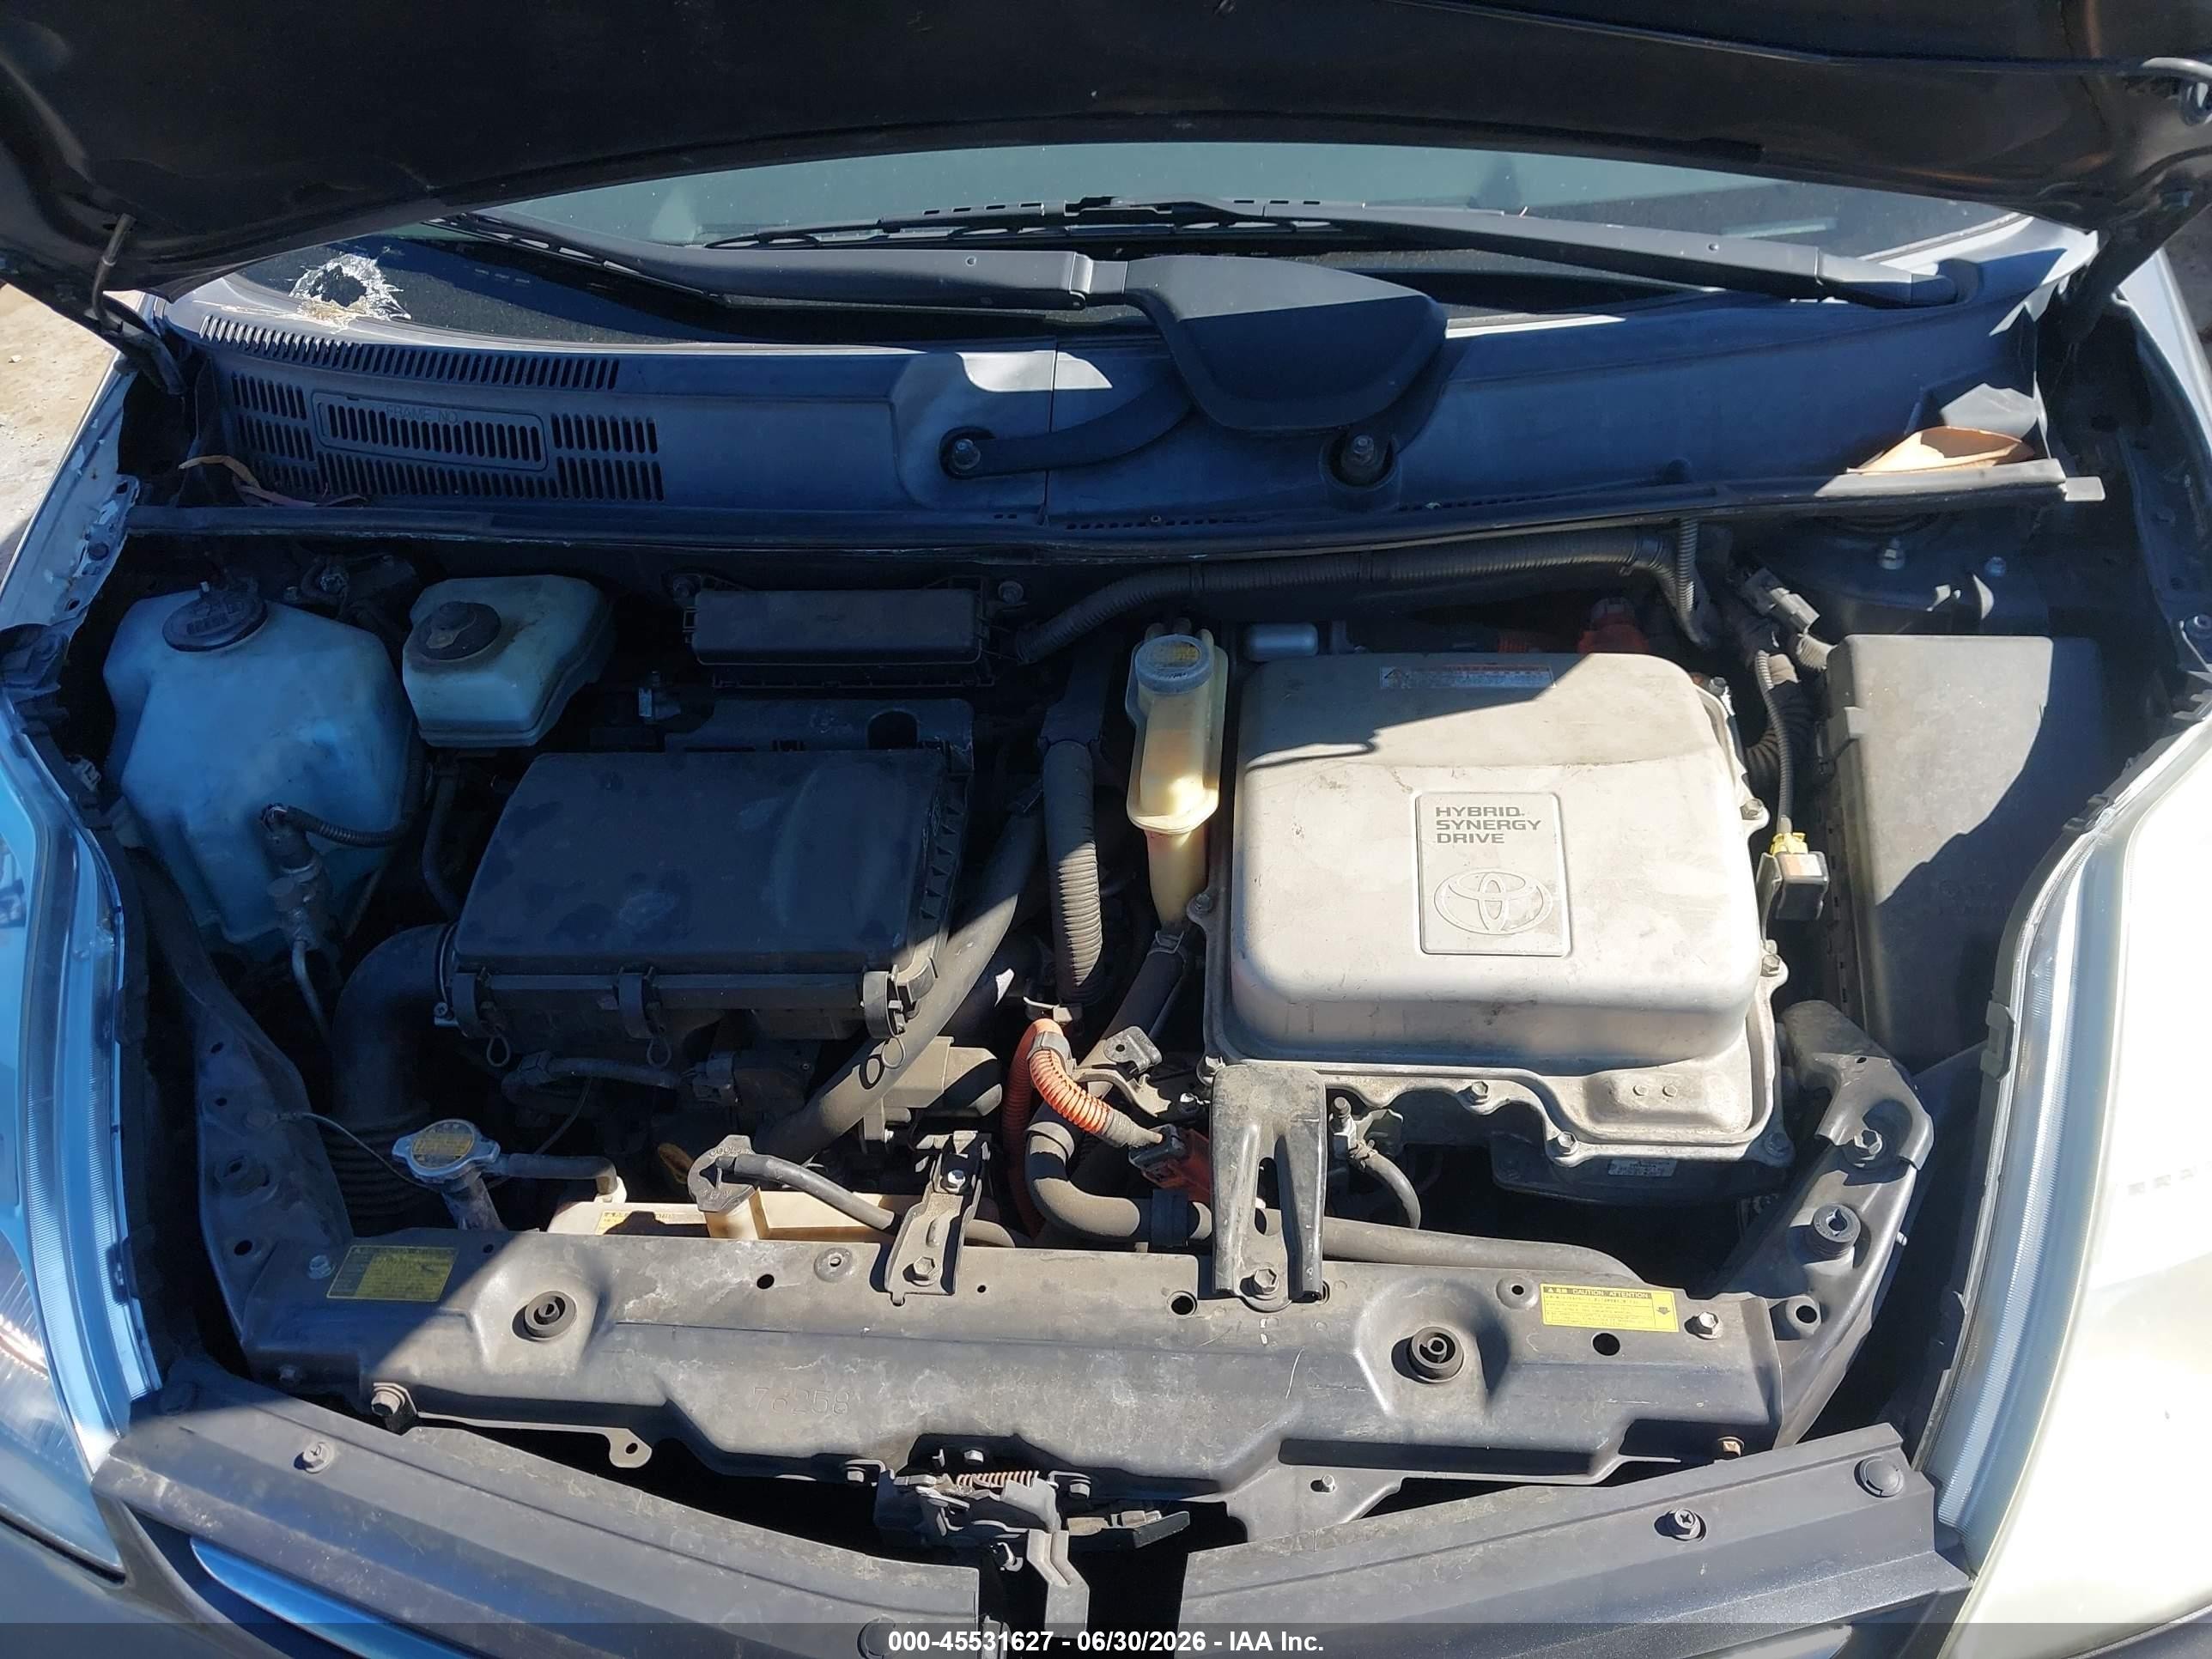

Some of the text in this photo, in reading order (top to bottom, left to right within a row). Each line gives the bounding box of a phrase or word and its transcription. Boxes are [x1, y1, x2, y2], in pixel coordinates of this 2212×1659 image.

[1435, 805, 1522, 817] HYBRID
[1436, 819, 1542, 831] SYNERGY
[1437, 833, 1505, 844] DRIVE
